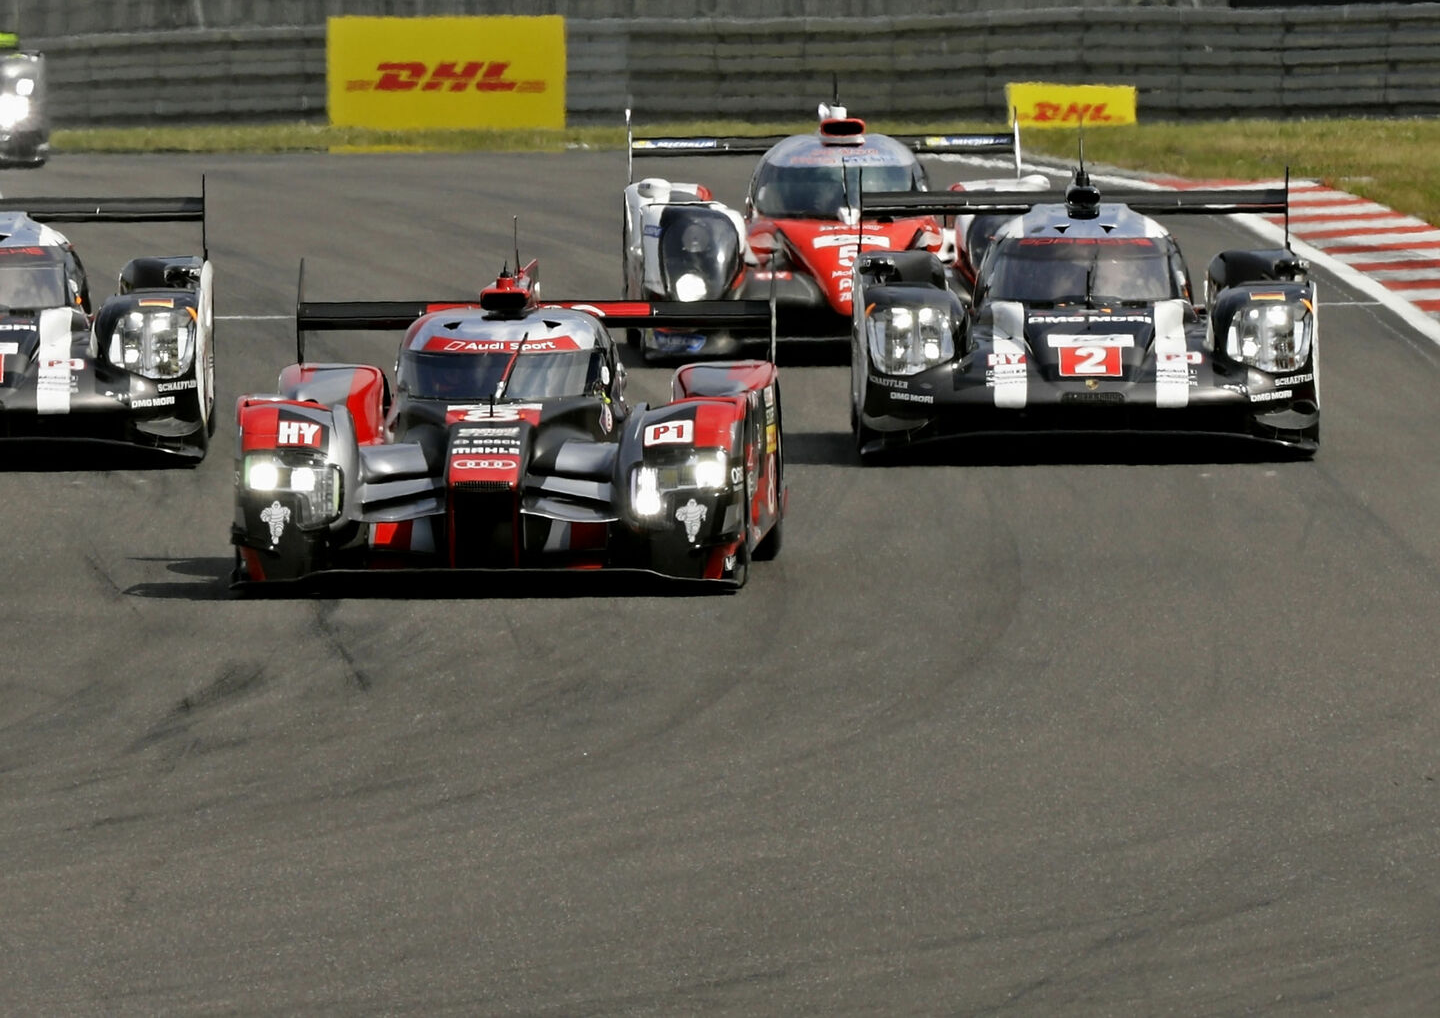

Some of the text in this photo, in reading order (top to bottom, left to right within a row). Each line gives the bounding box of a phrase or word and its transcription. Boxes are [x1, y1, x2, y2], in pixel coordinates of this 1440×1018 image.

[374, 61, 513, 92] DHL
[1033, 102, 1112, 122] DHL
[839, 244, 858, 267] 5
[1028, 316, 1152, 324] DMG MORI
[464, 340, 556, 352] Audi Sport
[1074, 346, 1107, 374] 2
[131, 396, 176, 409] DMG MORI
[889, 391, 934, 404] DMG MORI
[1250, 389, 1293, 403] DMG MORI
[279, 421, 320, 445] HY
[653, 424, 684, 441] P1
